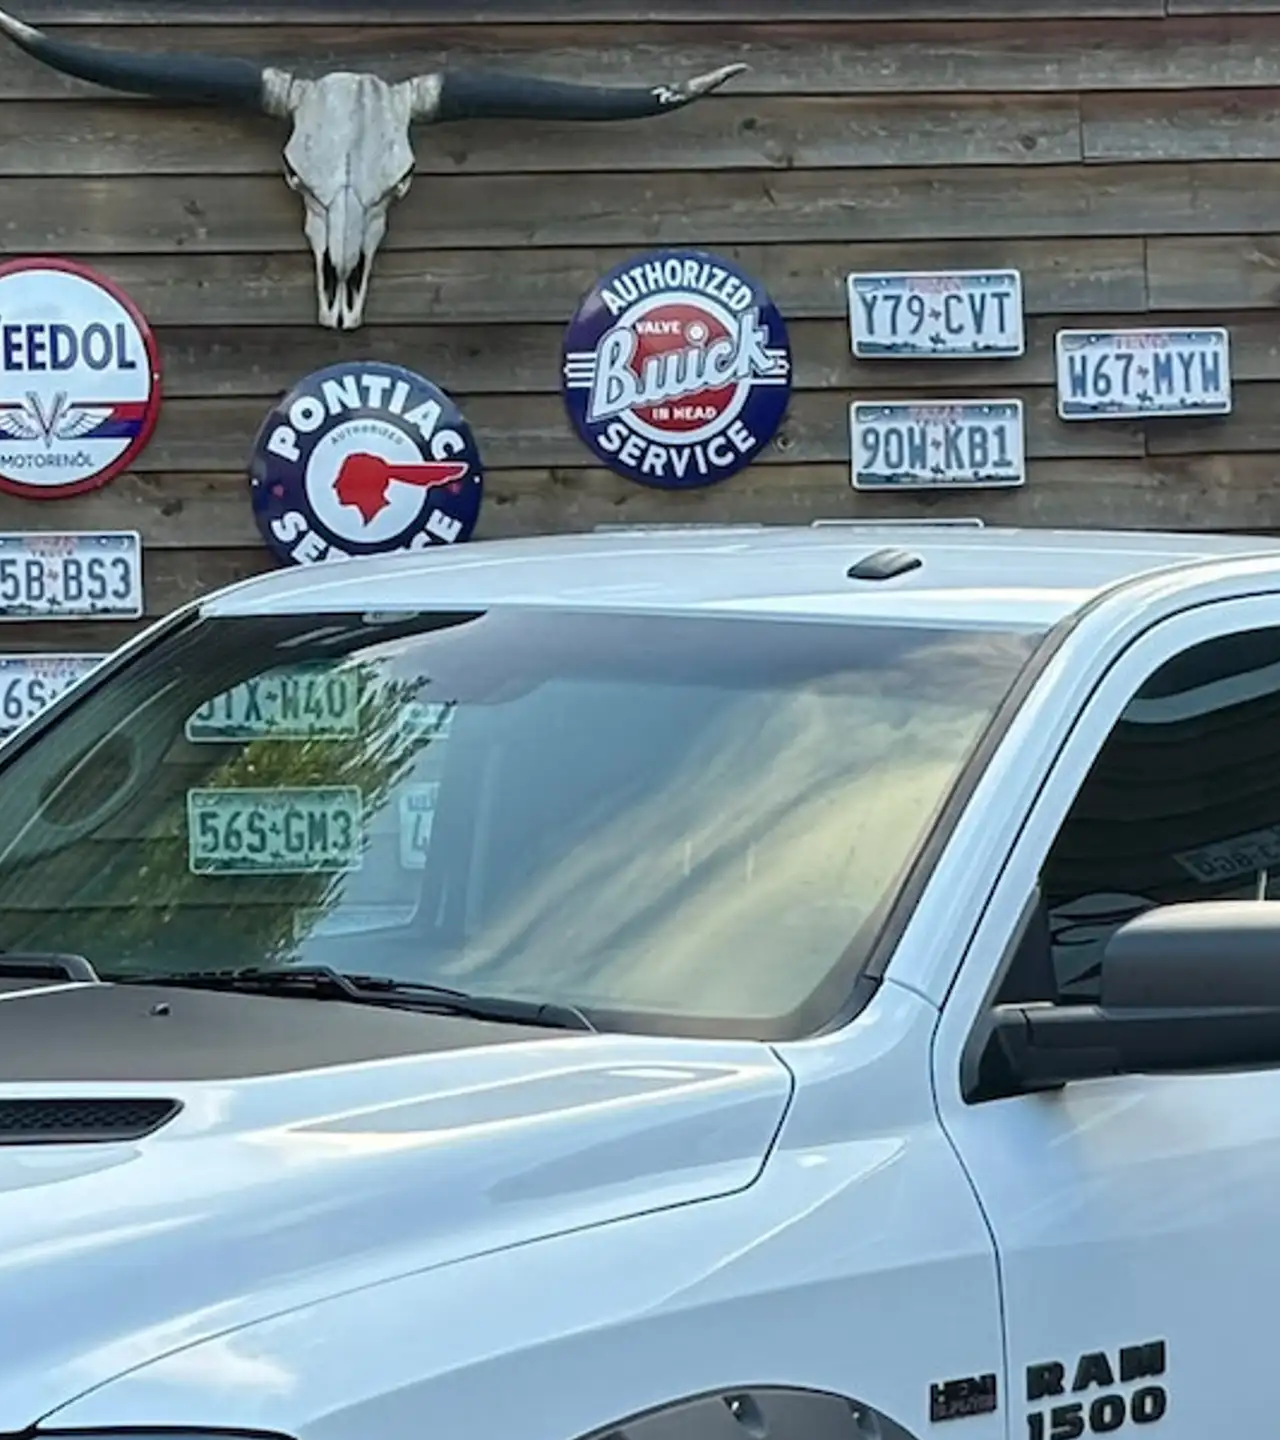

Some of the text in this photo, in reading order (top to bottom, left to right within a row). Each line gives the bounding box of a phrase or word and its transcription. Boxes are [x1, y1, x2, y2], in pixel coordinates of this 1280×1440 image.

[600, 259, 752, 316] AUTHORIZED
[635, 320, 681, 336] VALVE
[858, 292, 1011, 336] Y79 CVT
[586, 306, 776, 424] Buick
[1068, 352, 1135, 398] W67
[266, 374, 466, 463] PONTIAC
[651, 405, 718, 421] IN HEAD
[0, 452, 95, 469] MOTORENÖL
[597, 419, 757, 479] SERVICE
[62, 556, 132, 602] BS3
[1026, 1339, 1166, 1402] RAM
